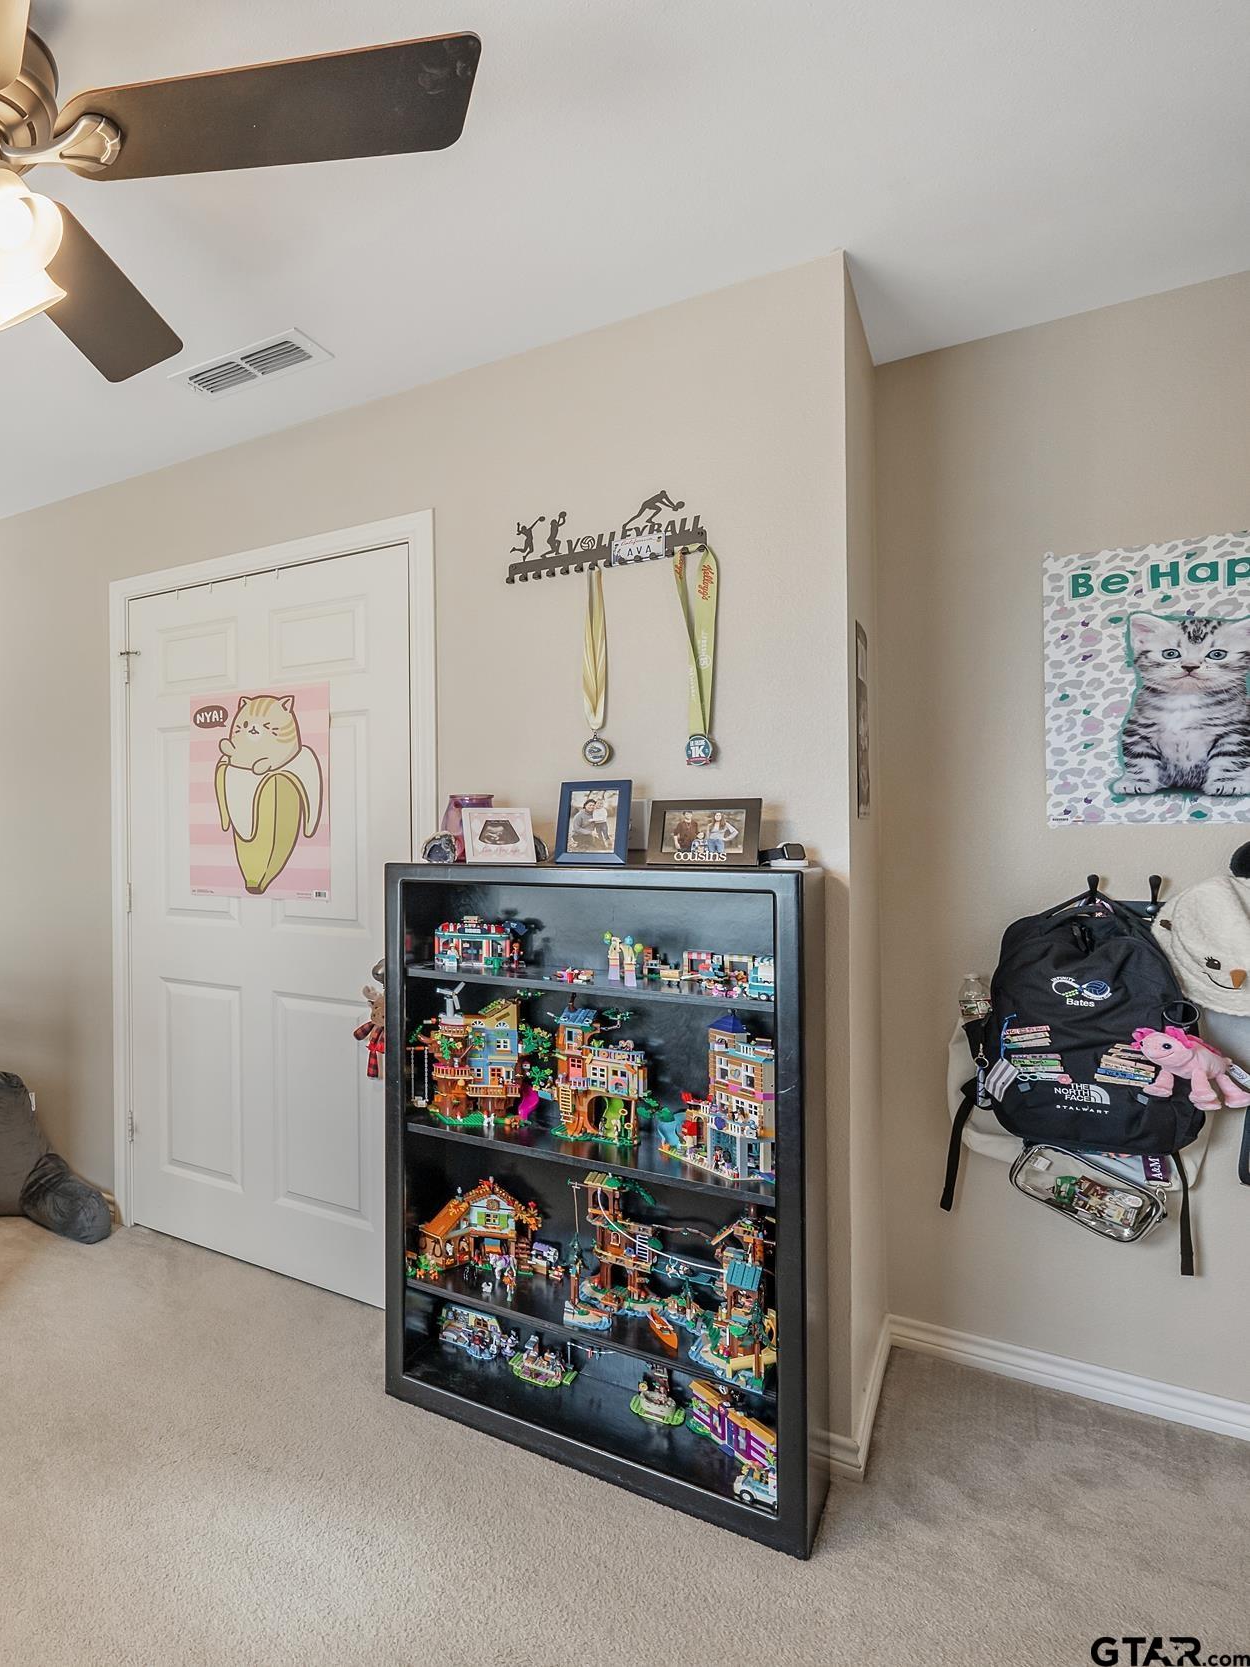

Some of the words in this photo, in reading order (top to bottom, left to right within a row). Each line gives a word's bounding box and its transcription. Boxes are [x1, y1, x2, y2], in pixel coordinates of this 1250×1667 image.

[626, 544, 652, 557] AVA
[697, 564, 715, 601] Kellogg's
[1071, 572, 1130, 599] Be
[196, 709, 223, 724] NYA!
[673, 850, 727, 861] cousins
[1066, 998, 1095, 1008] Bates
[1071, 1082, 1090, 1090] THE
[1053, 1087, 1090, 1097] NORTH
[1065, 1095, 1090, 1103] FACE
[1056, 1104, 1110, 1115] STALWART
